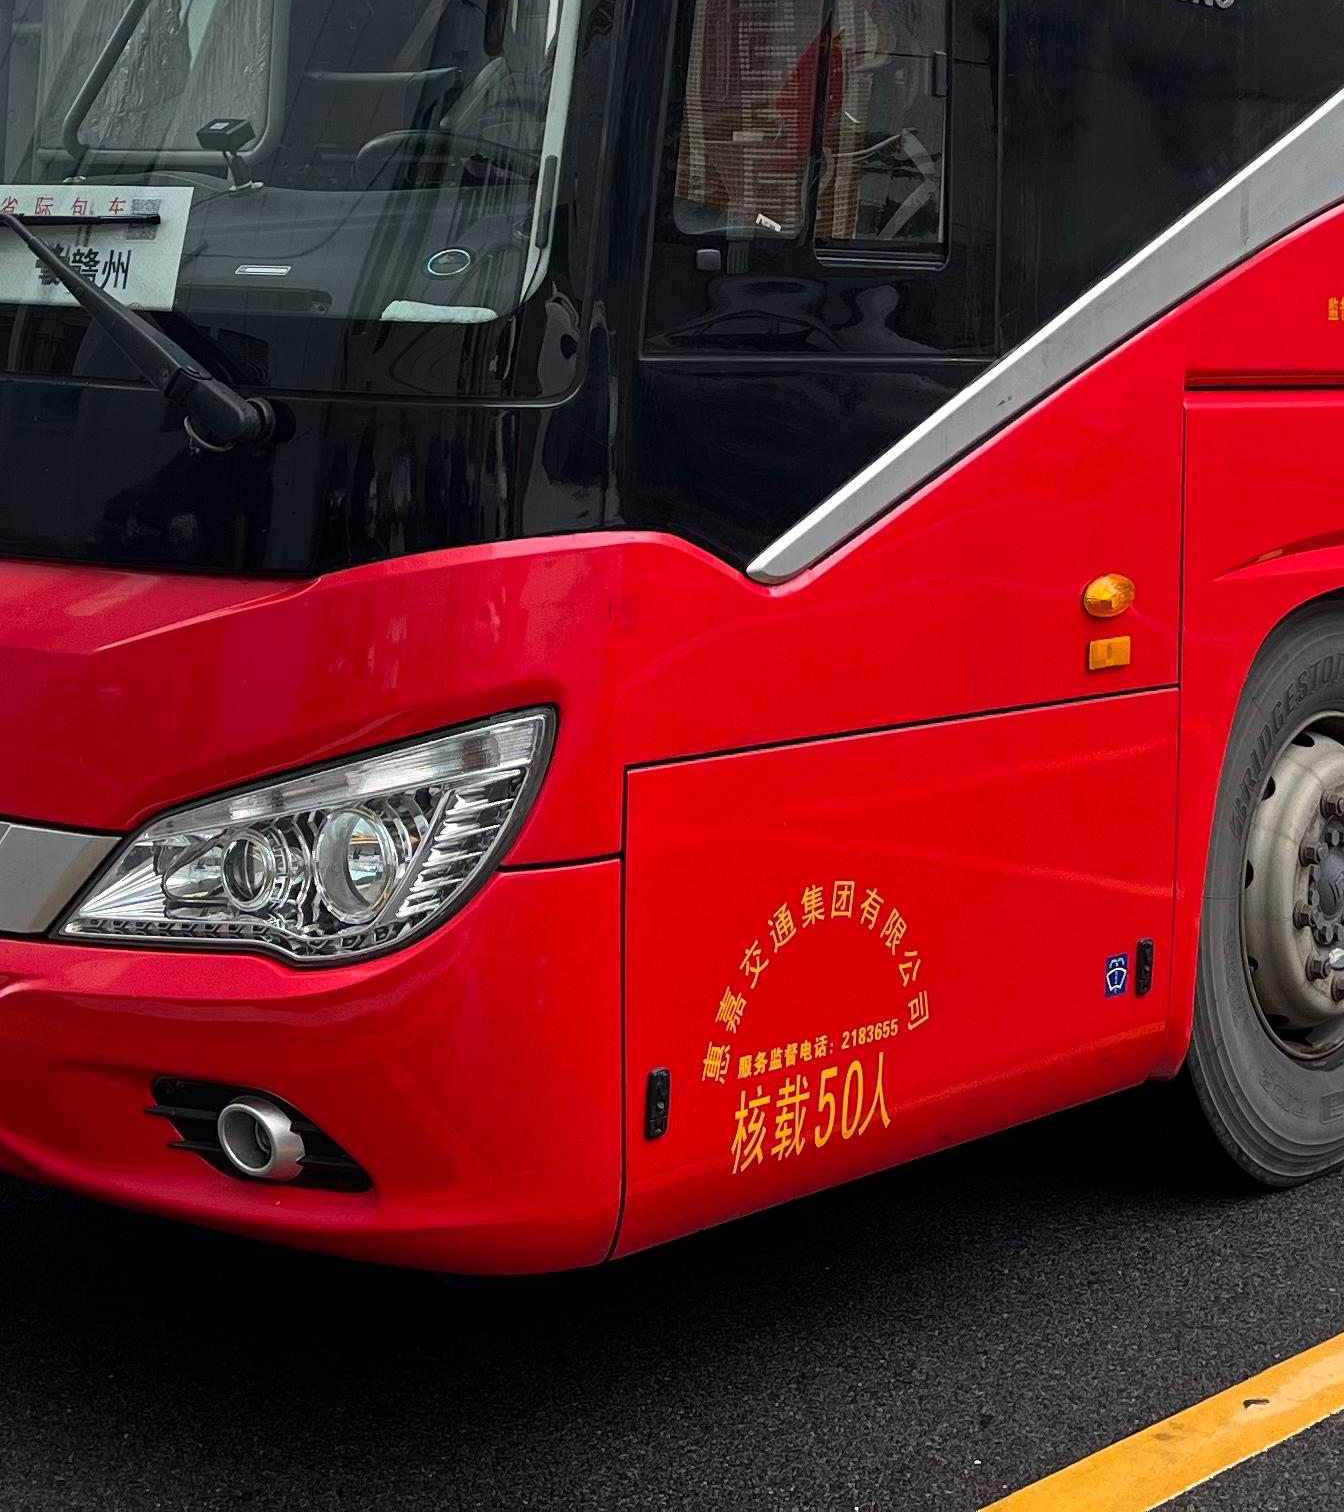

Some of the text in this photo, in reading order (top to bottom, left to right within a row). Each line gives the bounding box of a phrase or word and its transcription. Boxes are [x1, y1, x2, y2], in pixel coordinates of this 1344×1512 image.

[701, 880, 931, 1084] 惠嘉交通集团有限公司
[841, 1018, 899, 1050] 2183655
[731, 1051, 891, 1175] 核载50人
